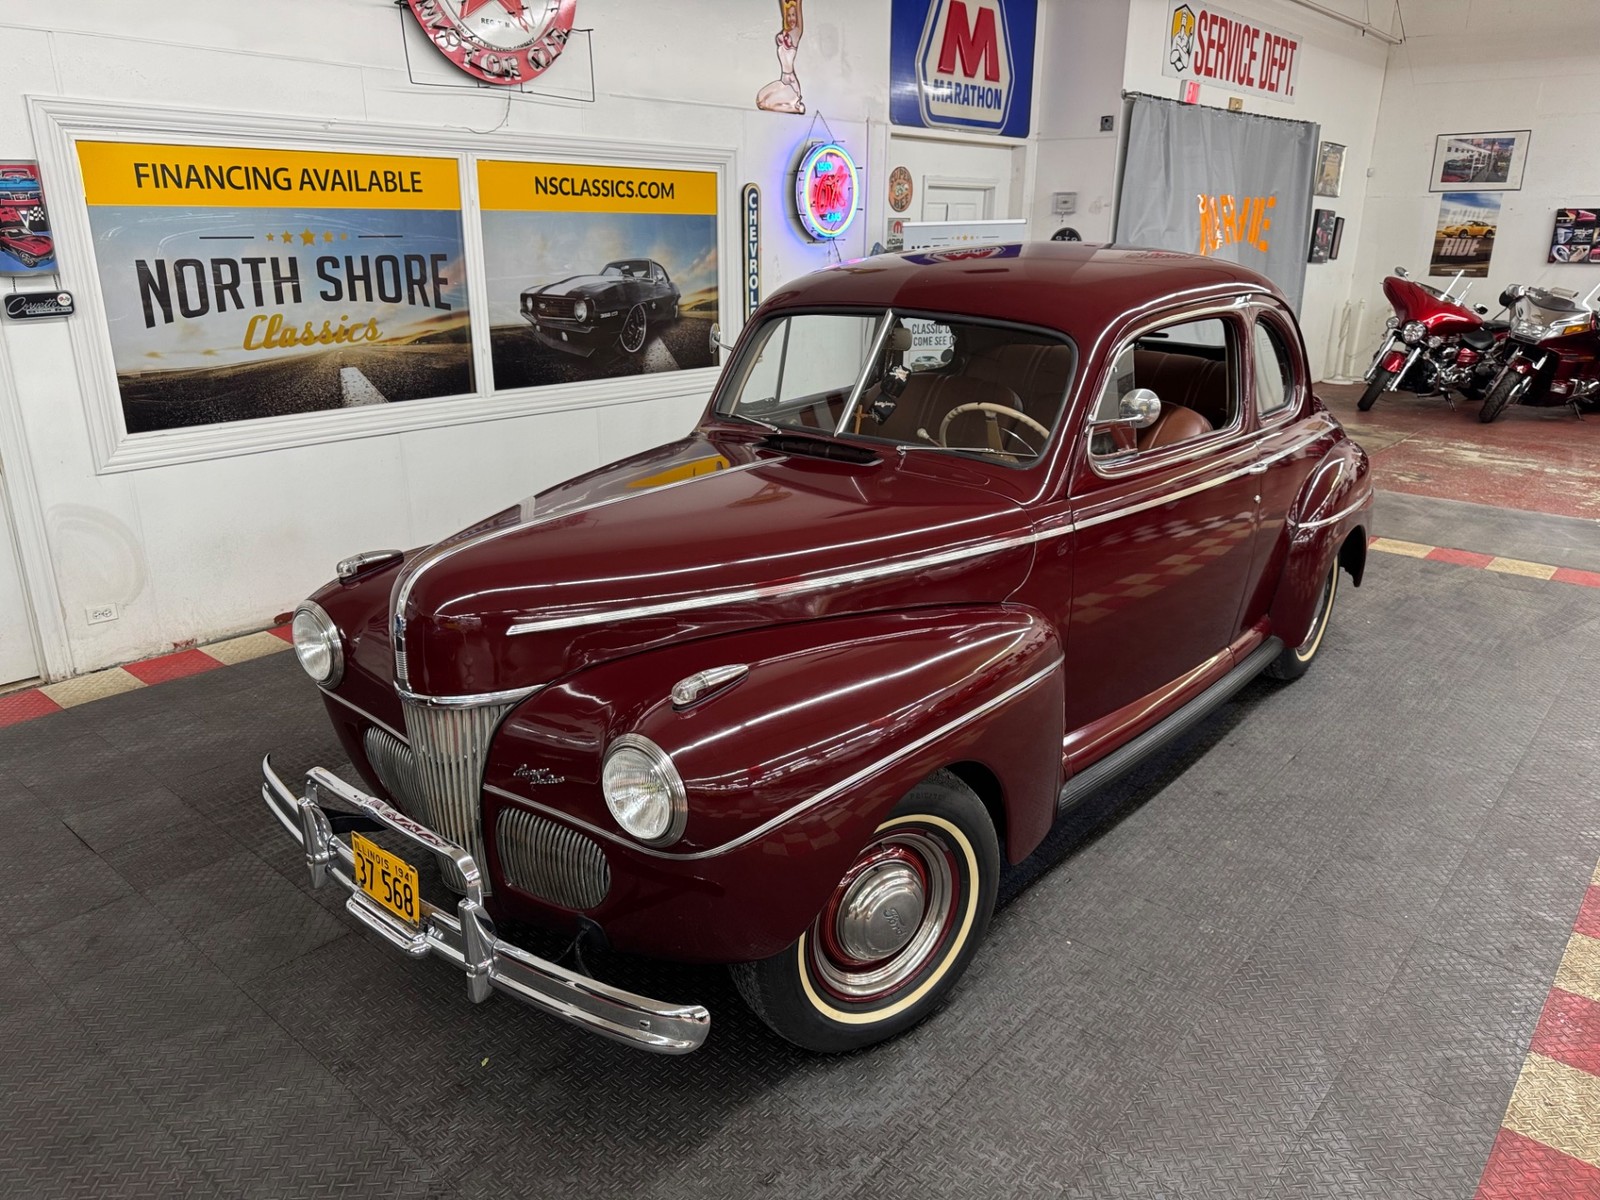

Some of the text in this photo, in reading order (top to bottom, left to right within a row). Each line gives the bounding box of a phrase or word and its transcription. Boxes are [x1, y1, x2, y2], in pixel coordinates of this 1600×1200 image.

[937, 0, 1000, 82] M
[1194, 10, 1297, 96] SERVICE DEPT.
[932, 79, 1002, 110] MARATHON
[134, 163, 423, 193] FINANCING AVAILABLE
[535, 176, 675, 200] NSCLASSICS.COM
[749, 192, 759, 316] CHEVROL
[1440, 237, 1480, 256] RIDE
[7, 296, 60, 315] Corvette
[135, 253, 452, 328] NORTH SHORE
[243, 313, 383, 351] Classics
[912, 323, 943, 334] CLASSIC
[913, 336, 933, 346] COME
[935, 335, 948, 346] SEE
[354, 840, 413, 884] ILLINOIS 1941
[357, 852, 413, 917] 37 568
[883, 907, 907, 938] Ford
